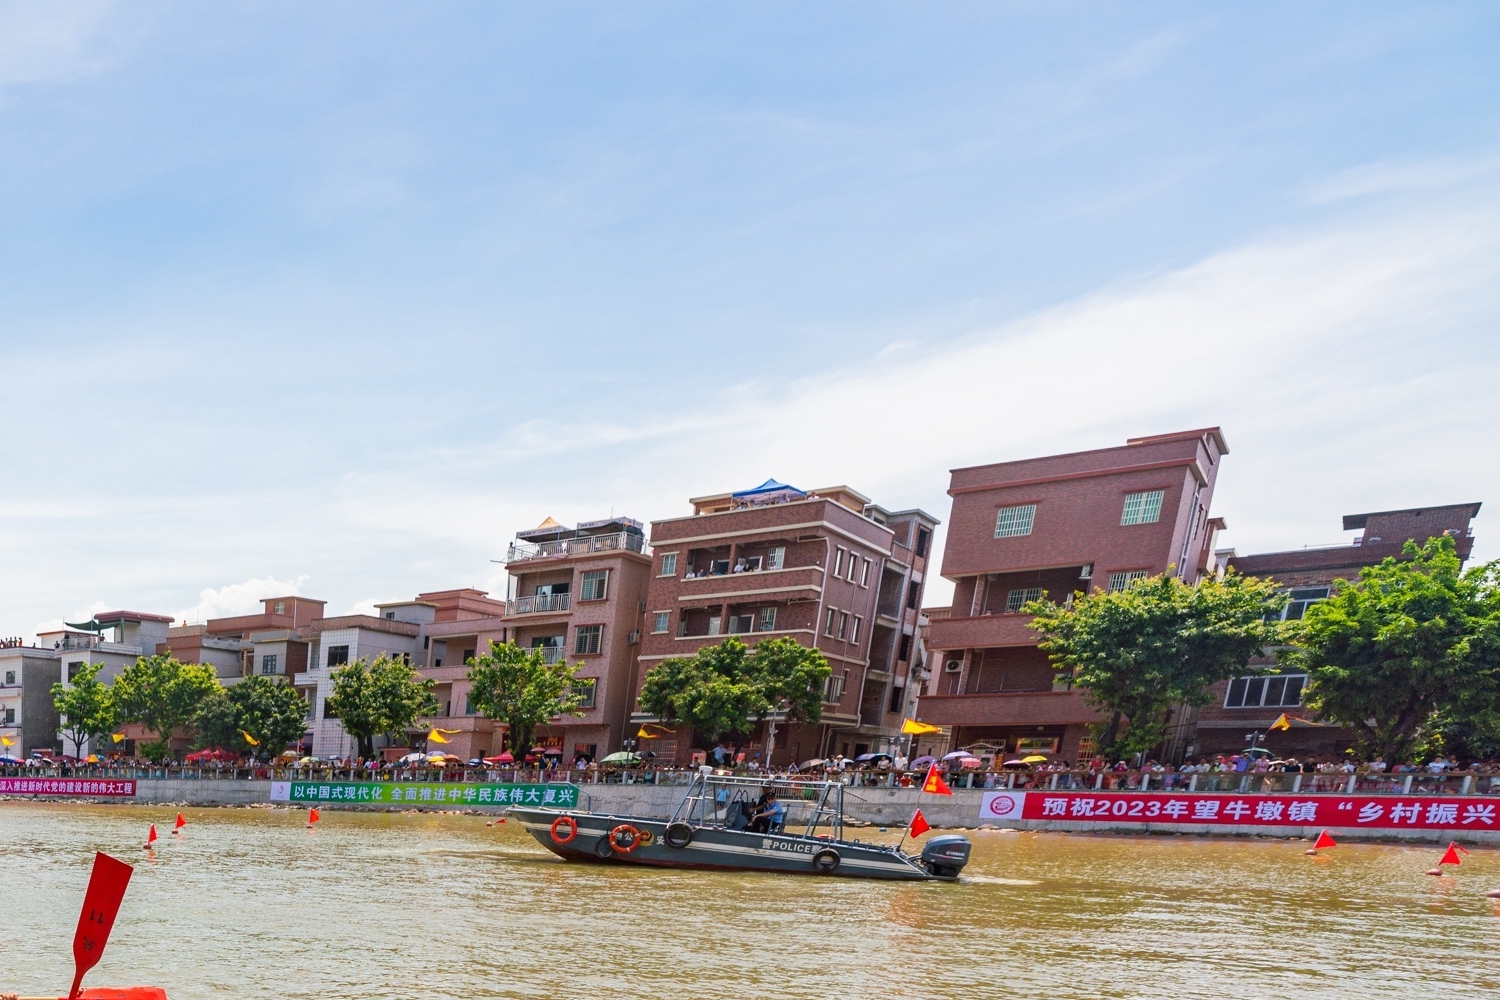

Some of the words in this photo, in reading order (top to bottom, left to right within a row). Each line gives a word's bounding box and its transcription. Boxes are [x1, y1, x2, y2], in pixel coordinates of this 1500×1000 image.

[0, 780, 133, 794] 深入推进新时代党的建设新的伟大工程
[294, 785, 383, 801] 以中国式现代化
[391, 787, 574, 804] 全面推进中华民族伟大复兴
[1042, 797, 1318, 822] 预祝2023年望牛墩镇
